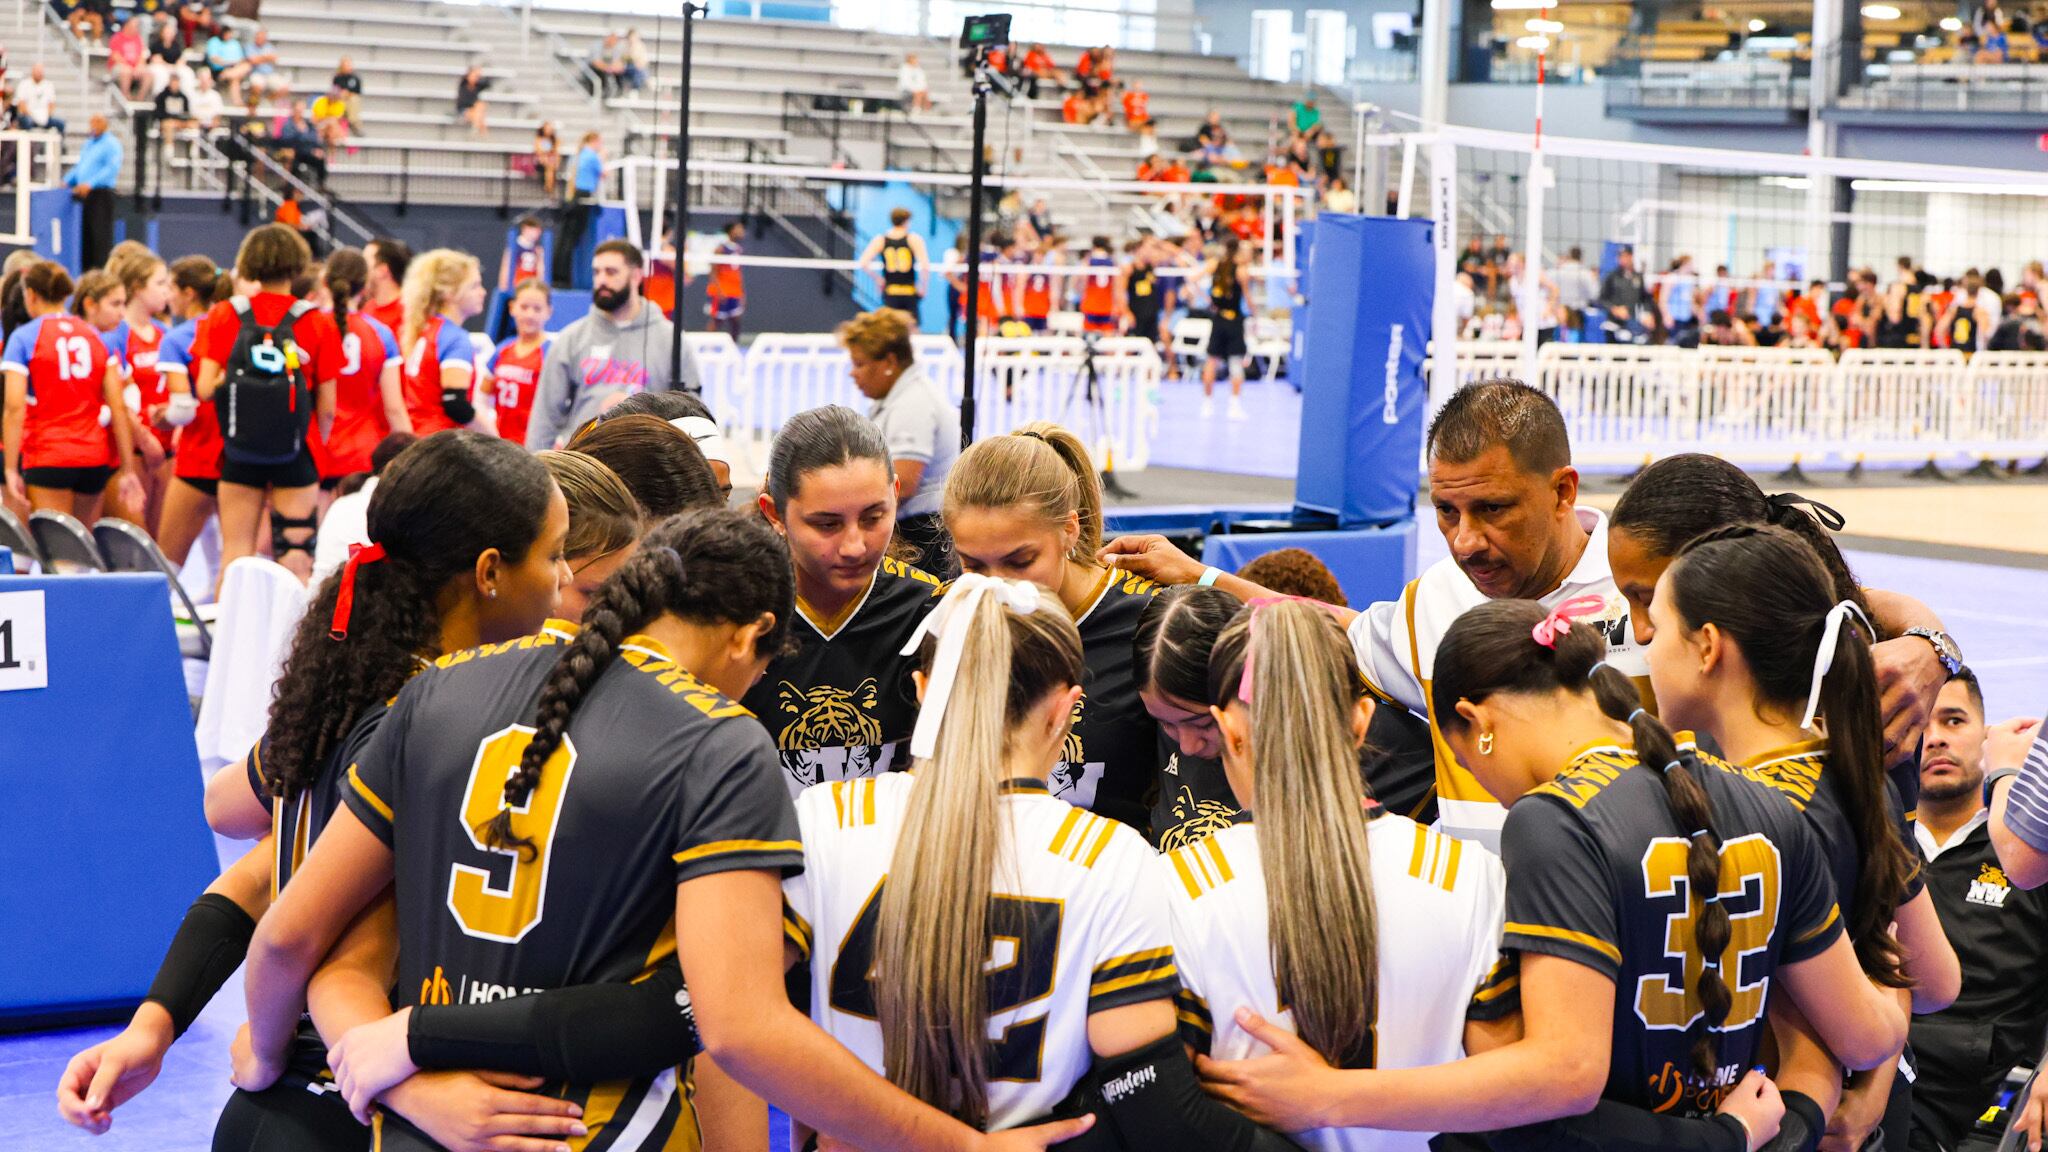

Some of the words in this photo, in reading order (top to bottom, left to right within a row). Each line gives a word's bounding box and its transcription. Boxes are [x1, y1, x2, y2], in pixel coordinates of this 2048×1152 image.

[56, 336, 92, 380] 13
[447, 723, 578, 944] 9
[469, 980, 545, 1005] HO
[1633, 832, 1782, 1033] 32
